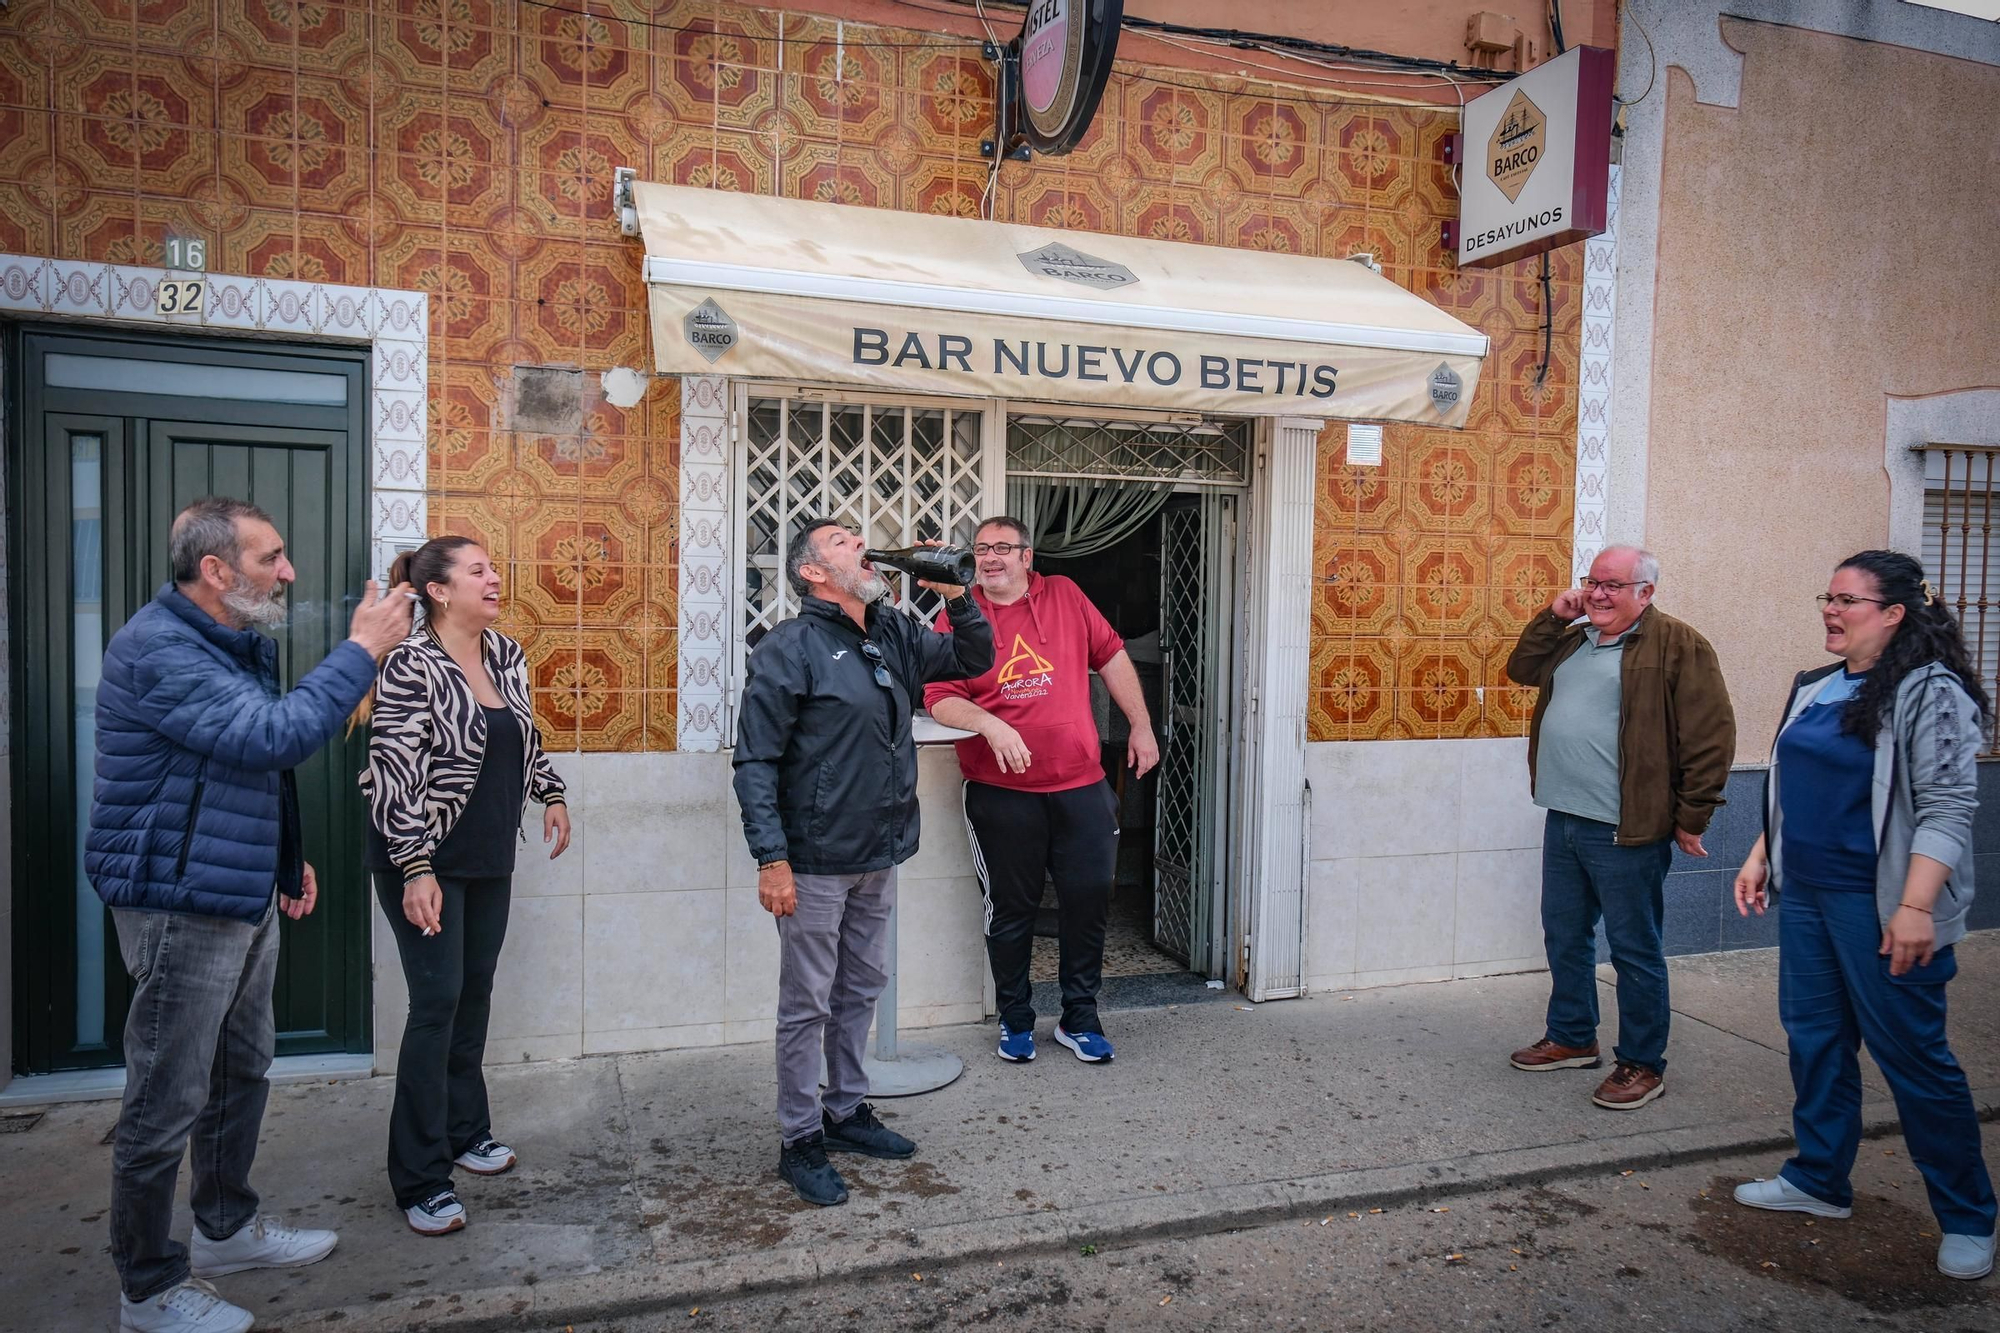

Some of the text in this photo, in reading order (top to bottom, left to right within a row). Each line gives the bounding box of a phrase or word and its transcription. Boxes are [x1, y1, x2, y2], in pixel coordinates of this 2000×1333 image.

[1024, 0, 1060, 46] MSTEL
[1494, 145, 1538, 178] BARCO
[1466, 207, 1562, 252] DESAYUNOS
[170, 240, 203, 269] 16
[1041, 267, 1127, 282] BARCO
[160, 283, 202, 312] 32
[691, 331, 732, 345] BARCO
[853, 327, 1339, 398] BAR NUEVO BETIS
[1432, 388, 1458, 401] BARCO
